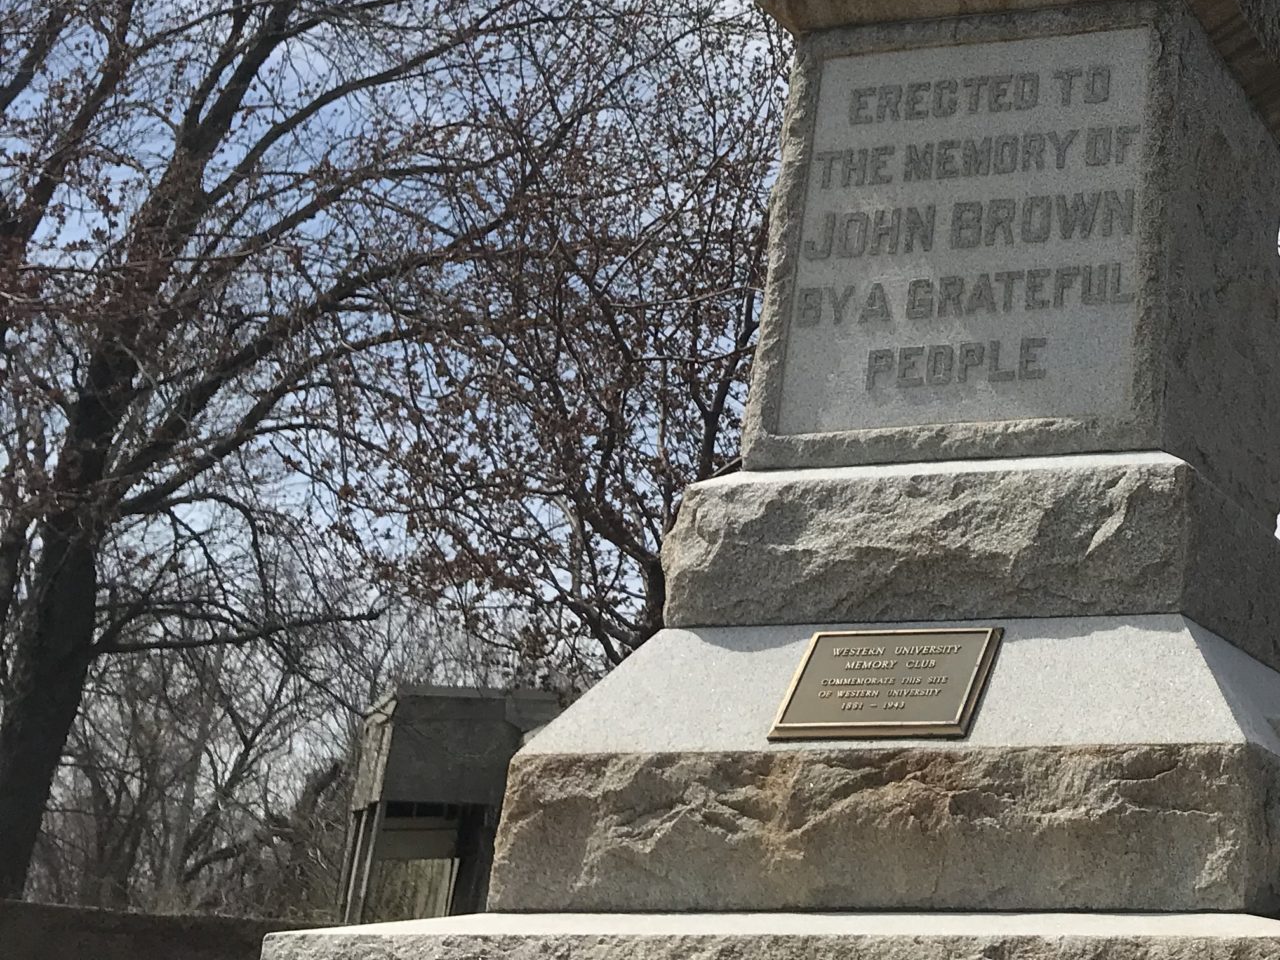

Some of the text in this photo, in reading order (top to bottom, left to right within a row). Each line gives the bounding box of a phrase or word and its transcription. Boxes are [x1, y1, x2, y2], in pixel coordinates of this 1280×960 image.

[848, 65, 1111, 126] ERECTED TO
[813, 124, 1141, 190] THE MEMORY OF
[803, 188, 1136, 261] JOHN BROWN
[799, 262, 1136, 328] BY A GRATEFUL
[866, 337, 1047, 391] PEOPLE
[832, 644, 962, 656] WESTERN UNIVERSITY
[845, 659, 937, 670] MEMORY CLUB
[818, 688, 942, 698] OF WESTERN UNIVERSITY
[820, 675, 948, 687] COMMEMORATE THIS SITE
[882, 701, 905, 710] 1943
